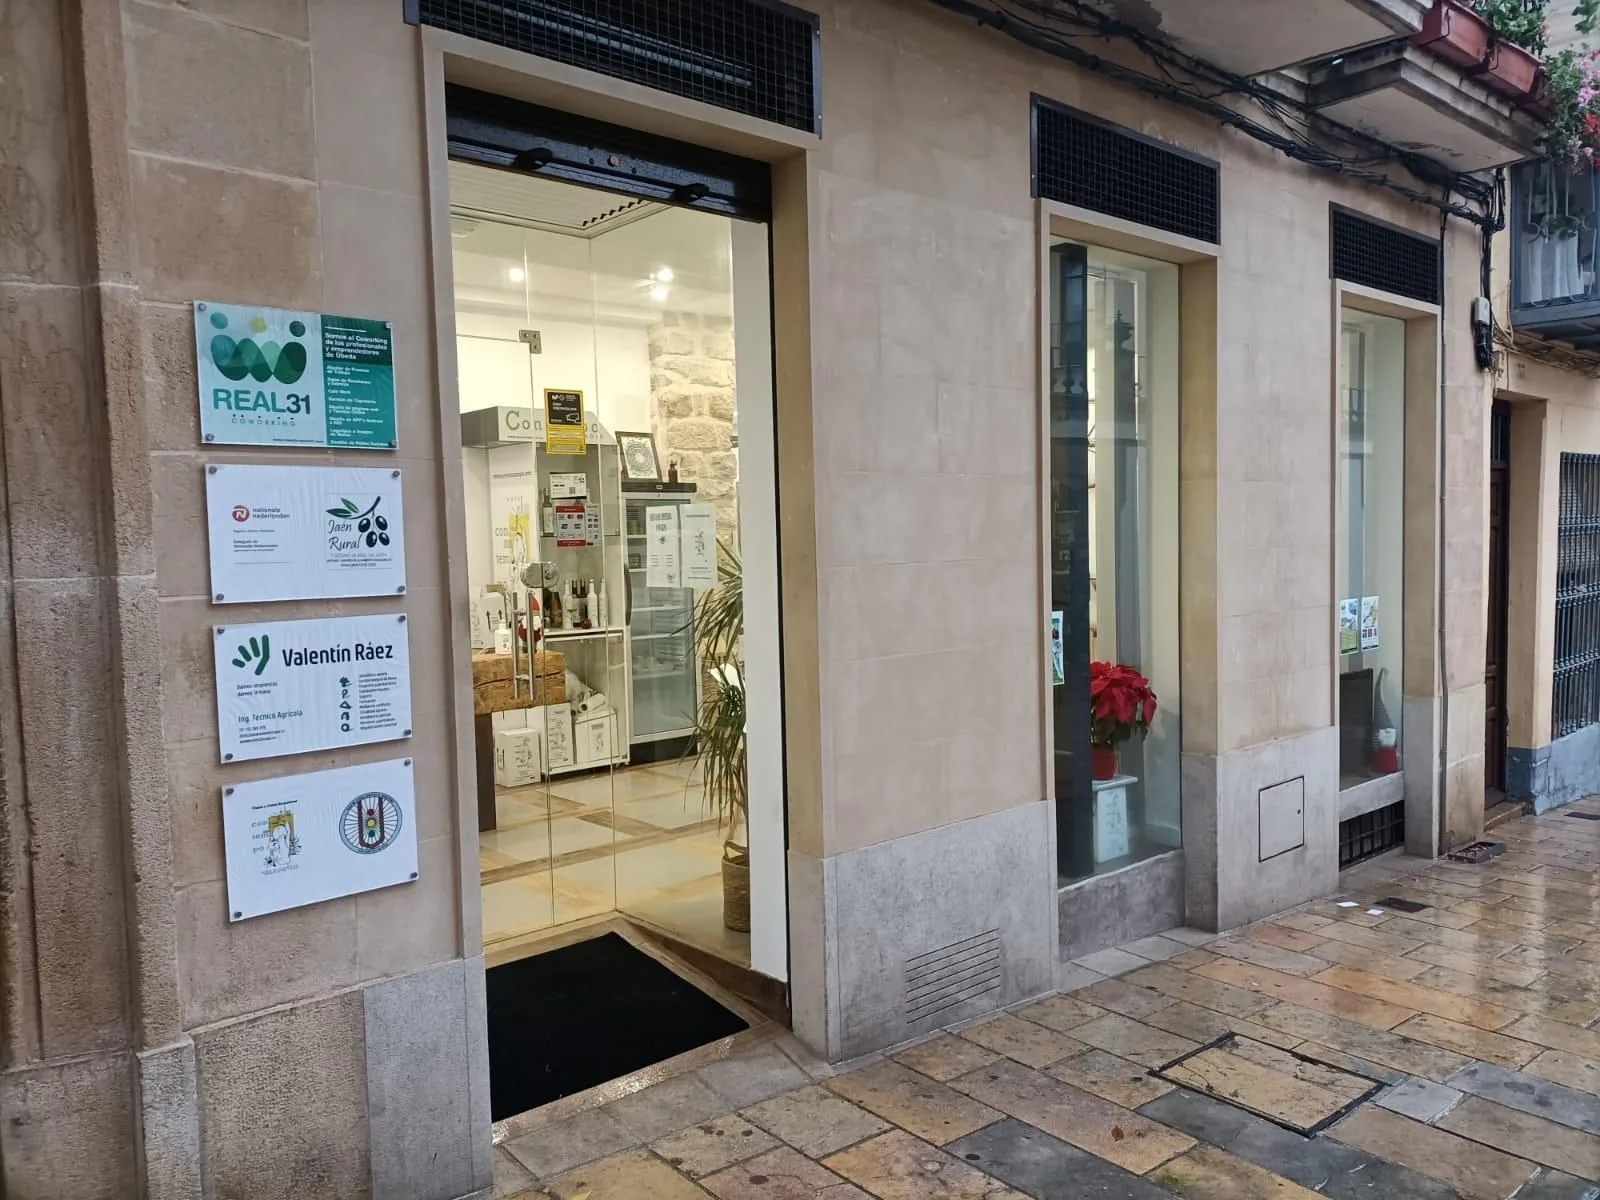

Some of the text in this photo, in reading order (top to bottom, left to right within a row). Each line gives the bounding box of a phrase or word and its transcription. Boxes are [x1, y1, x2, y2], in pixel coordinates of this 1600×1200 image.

[212, 388, 311, 415] REAL31
[328, 533, 363, 551] Rural
[282, 641, 394, 667] Valentín Ráez
